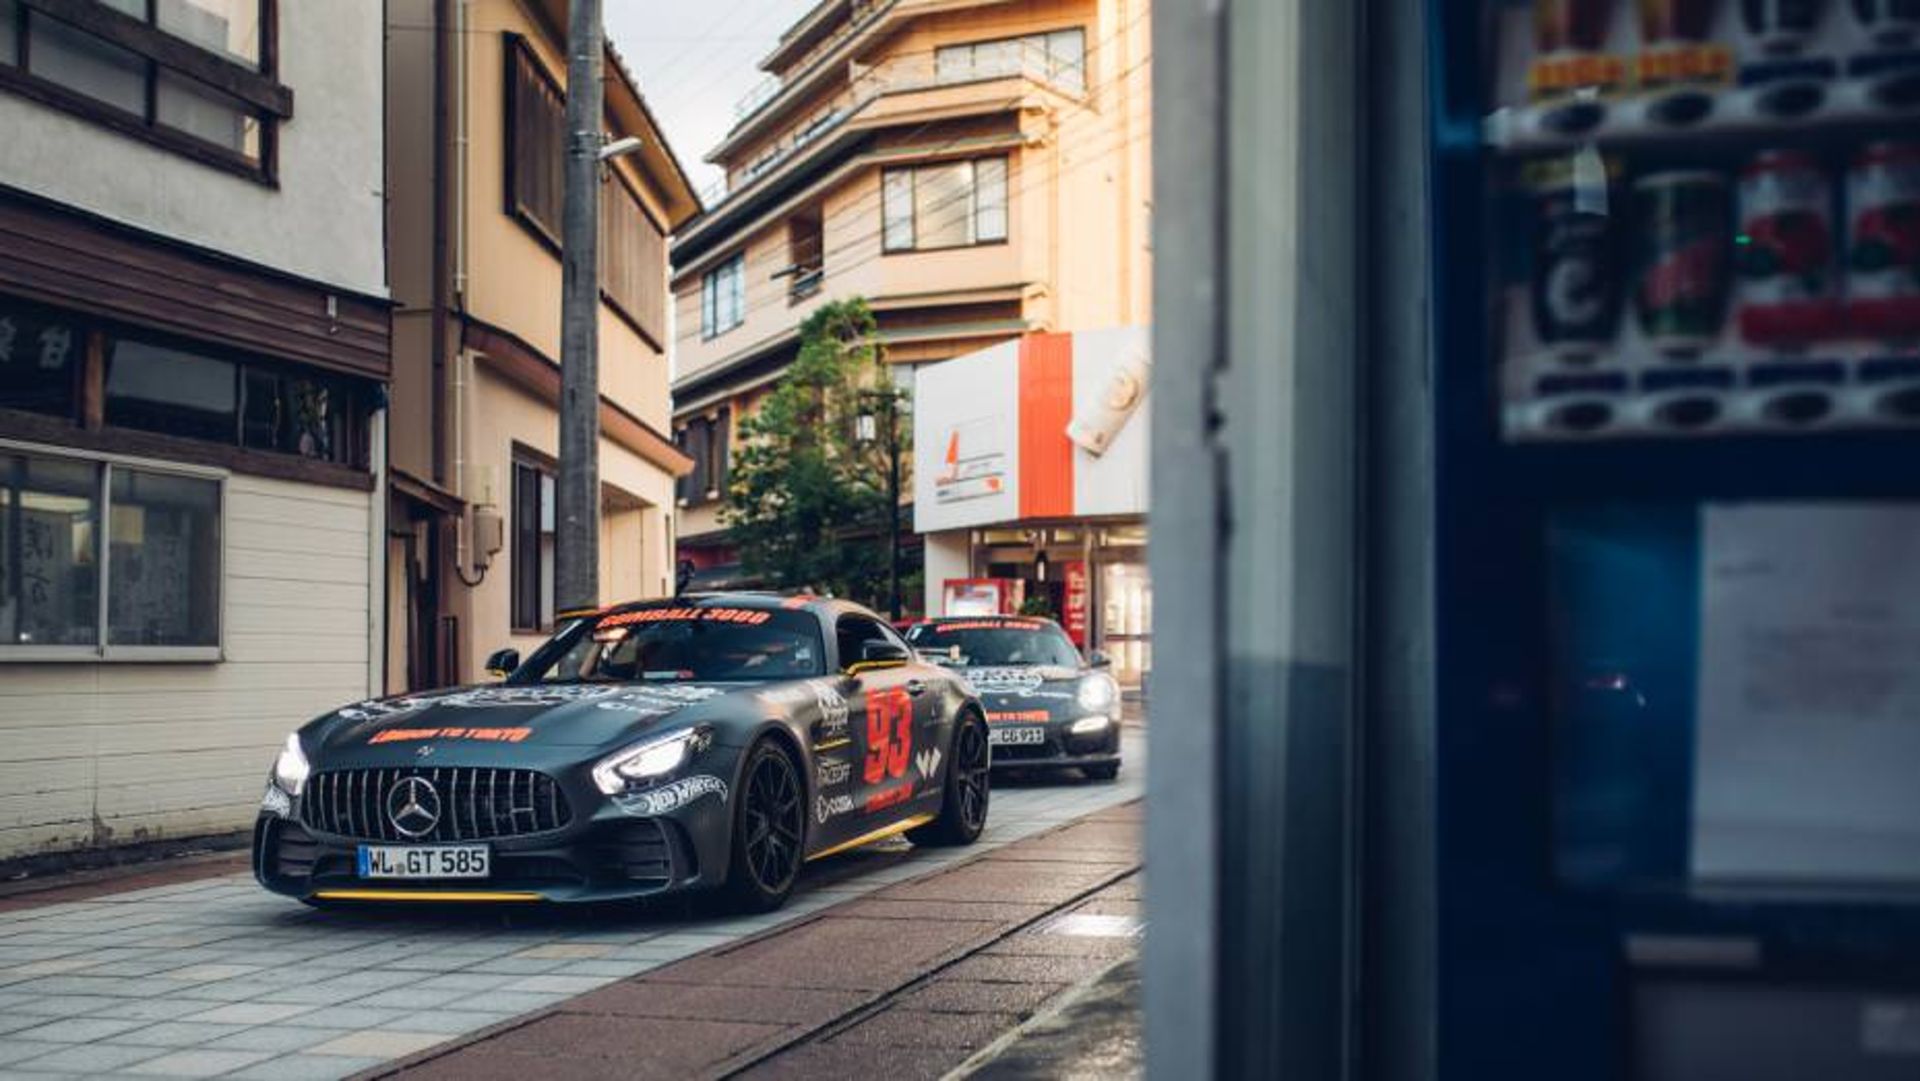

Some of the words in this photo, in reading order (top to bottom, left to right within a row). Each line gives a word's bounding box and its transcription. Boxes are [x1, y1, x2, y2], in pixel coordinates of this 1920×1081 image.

[596, 607, 702, 629] GUMBALL
[704, 607, 772, 626] 3000
[864, 686, 912, 784] 93
[369, 850, 394, 874] WL
[406, 850, 436, 874] GT
[440, 849, 485, 874] 585
